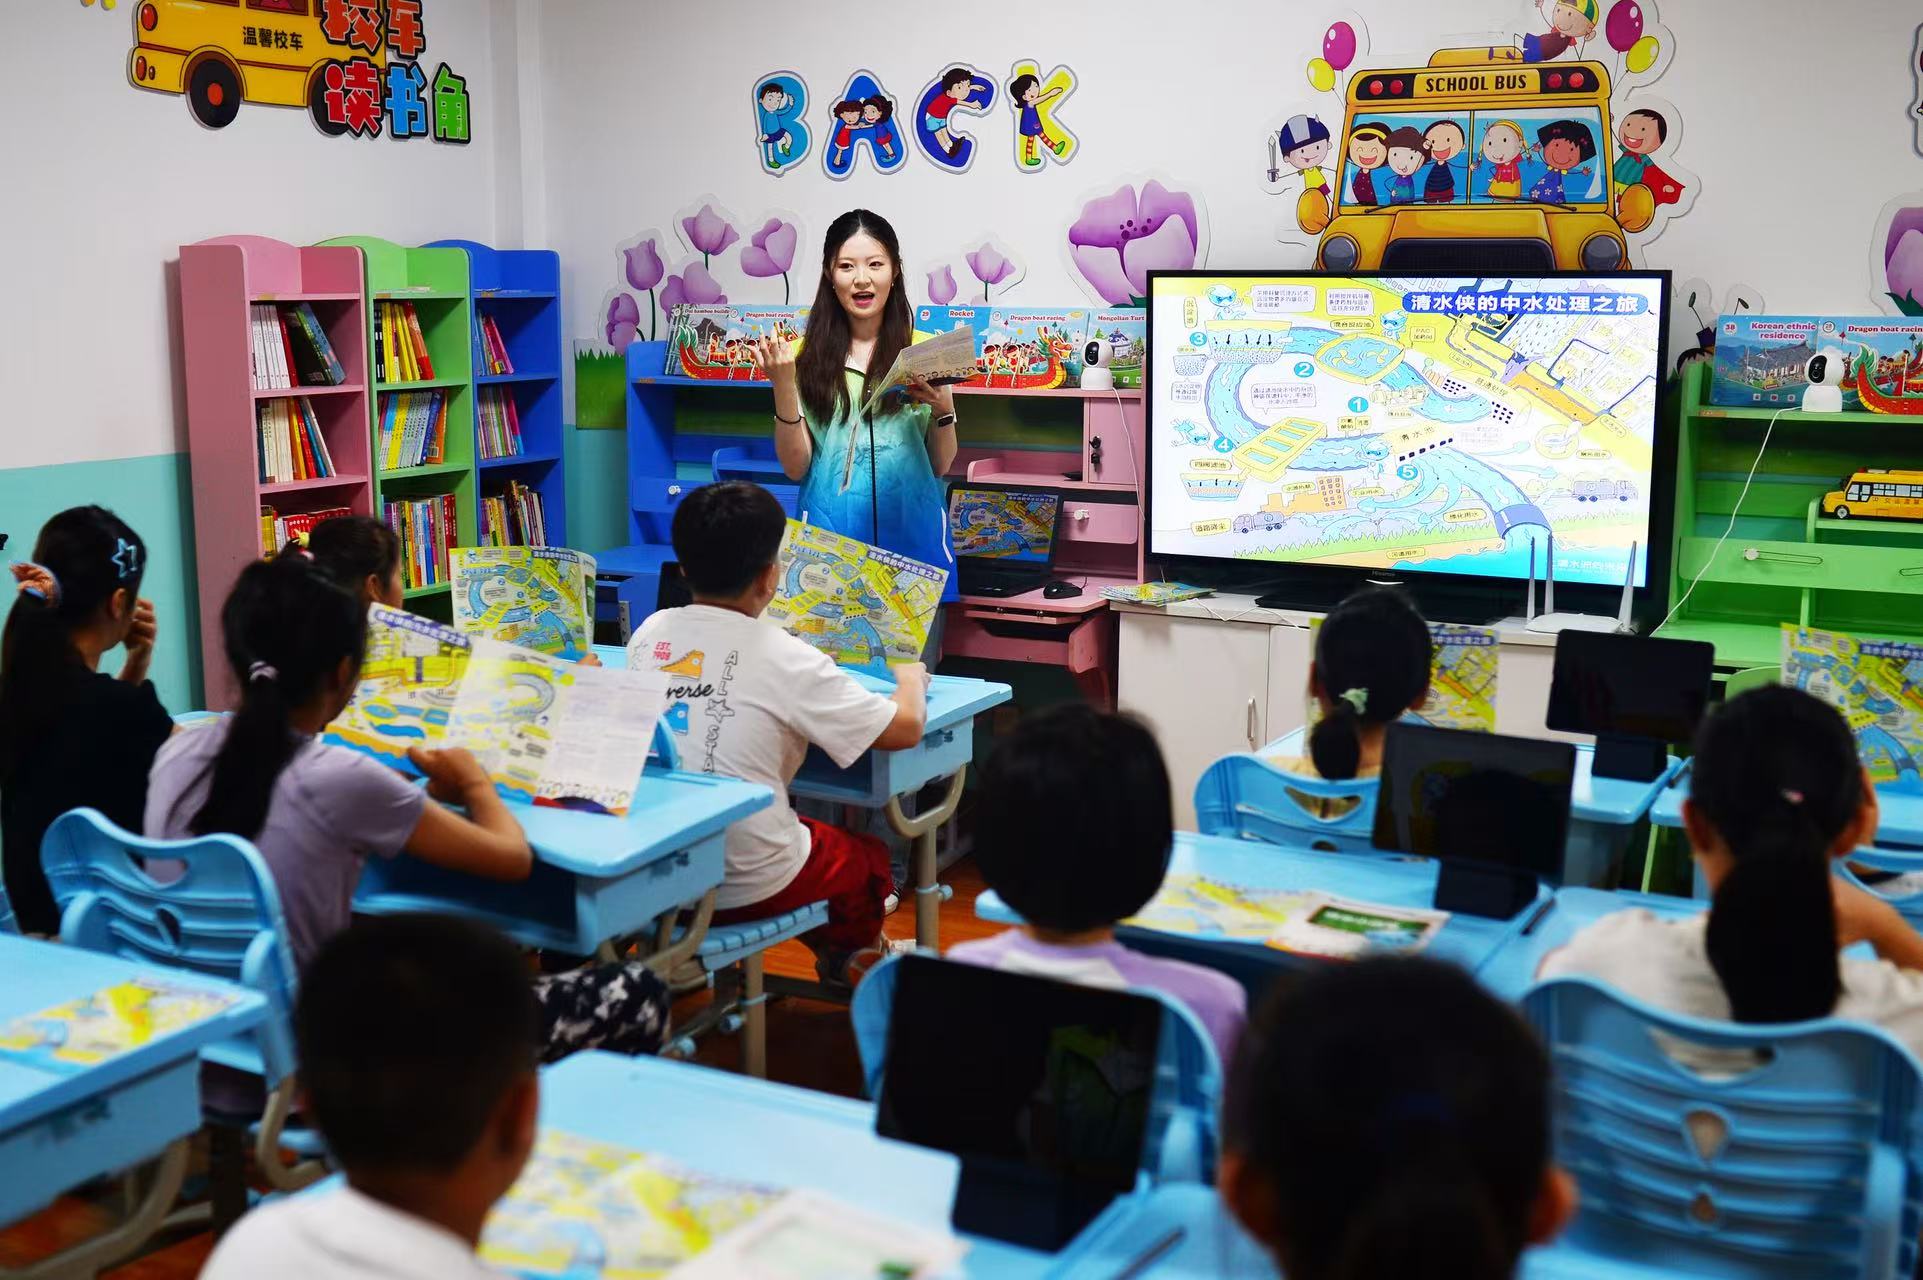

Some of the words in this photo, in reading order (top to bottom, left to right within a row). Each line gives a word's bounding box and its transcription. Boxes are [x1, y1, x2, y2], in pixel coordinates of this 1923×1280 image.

[242, 26, 304, 51] 温馨校车
[1425, 76, 1489, 93] SCHOOL
[1494, 74, 1527, 90] BUS
[323, 60, 470, 142] 读书角
[755, 63, 1077, 177] BACK
[1411, 294, 1639, 313] 清水侠的中水处理之旅
[1751, 322, 1784, 330] Korean
[1786, 322, 1816, 331] ethnic
[1760, 331, 1806, 340] residence
[1848, 325, 1879, 333] Dragon
